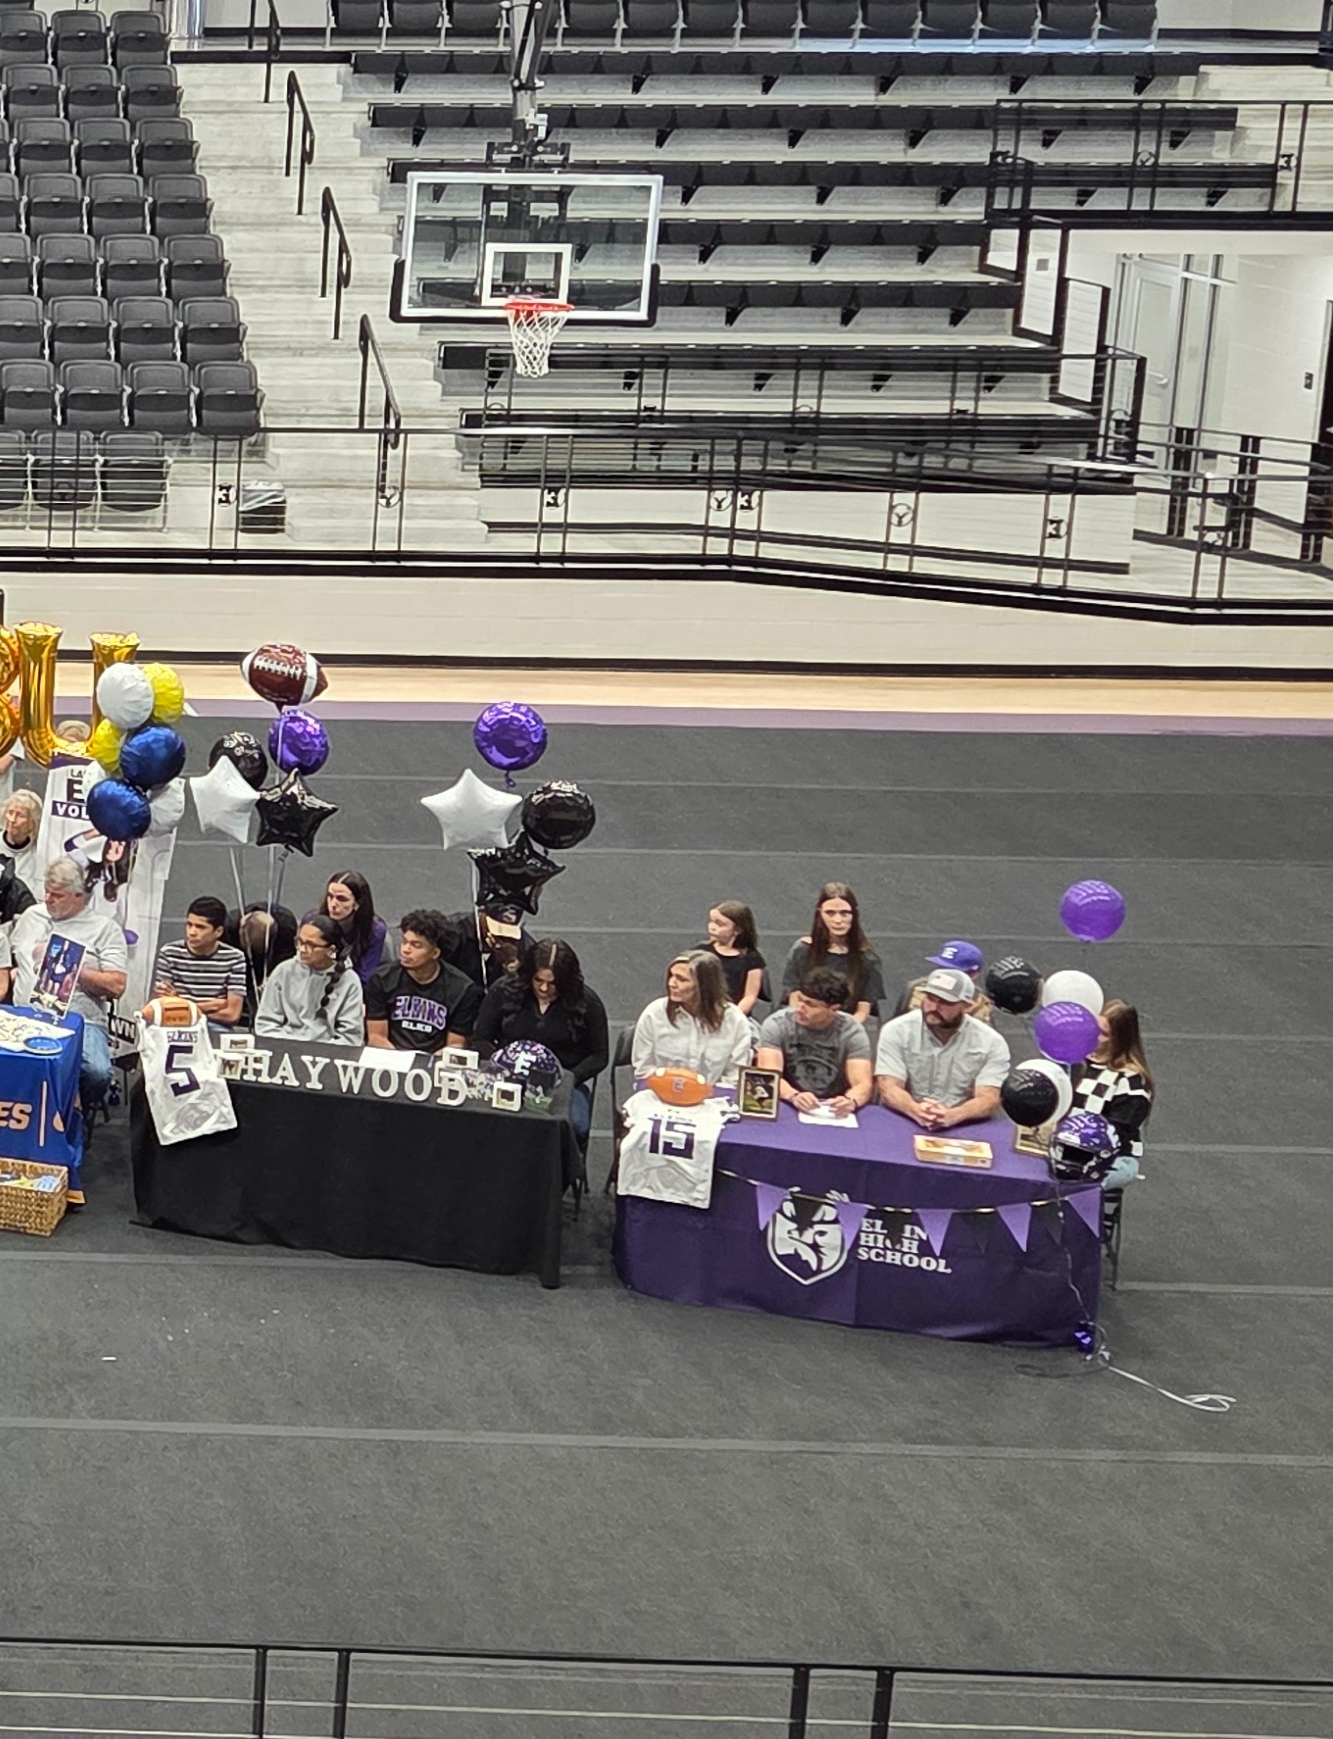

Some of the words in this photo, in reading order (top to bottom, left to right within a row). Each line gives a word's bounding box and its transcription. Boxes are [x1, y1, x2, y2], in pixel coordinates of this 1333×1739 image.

[164, 1045, 201, 1097] 5
[243, 1050, 468, 1106] HAYWOOD
[647, 1118, 697, 1160] 15
[859, 1231, 919, 1254] HIH
[861, 1218, 928, 1241] ELIN
[857, 1247, 953, 1274] SCHOOL
